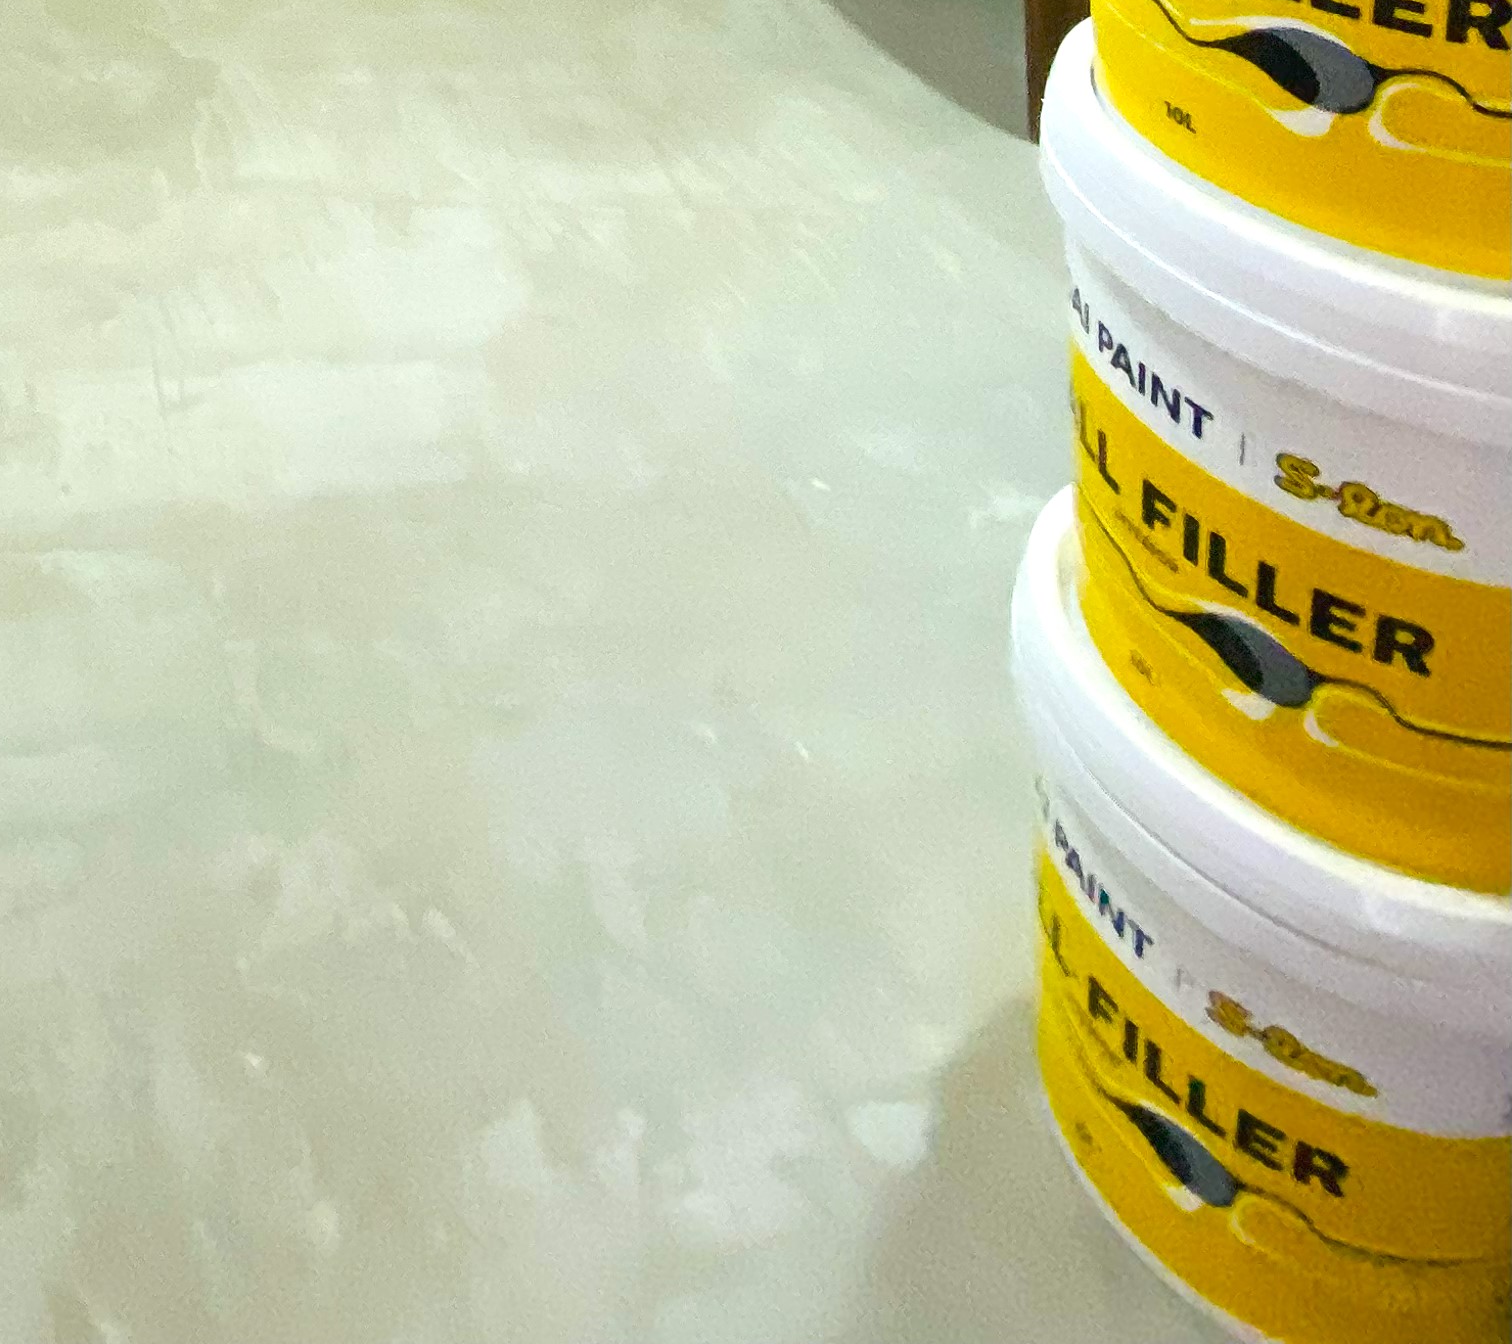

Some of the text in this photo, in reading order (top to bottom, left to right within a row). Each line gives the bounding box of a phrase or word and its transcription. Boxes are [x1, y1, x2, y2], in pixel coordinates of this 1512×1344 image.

[1098, 319, 1214, 440] PAINT
[1078, 400, 1120, 495] LL
[1141, 478, 1436, 678] FILLER
[1088, 975, 1352, 1198] FILLER
